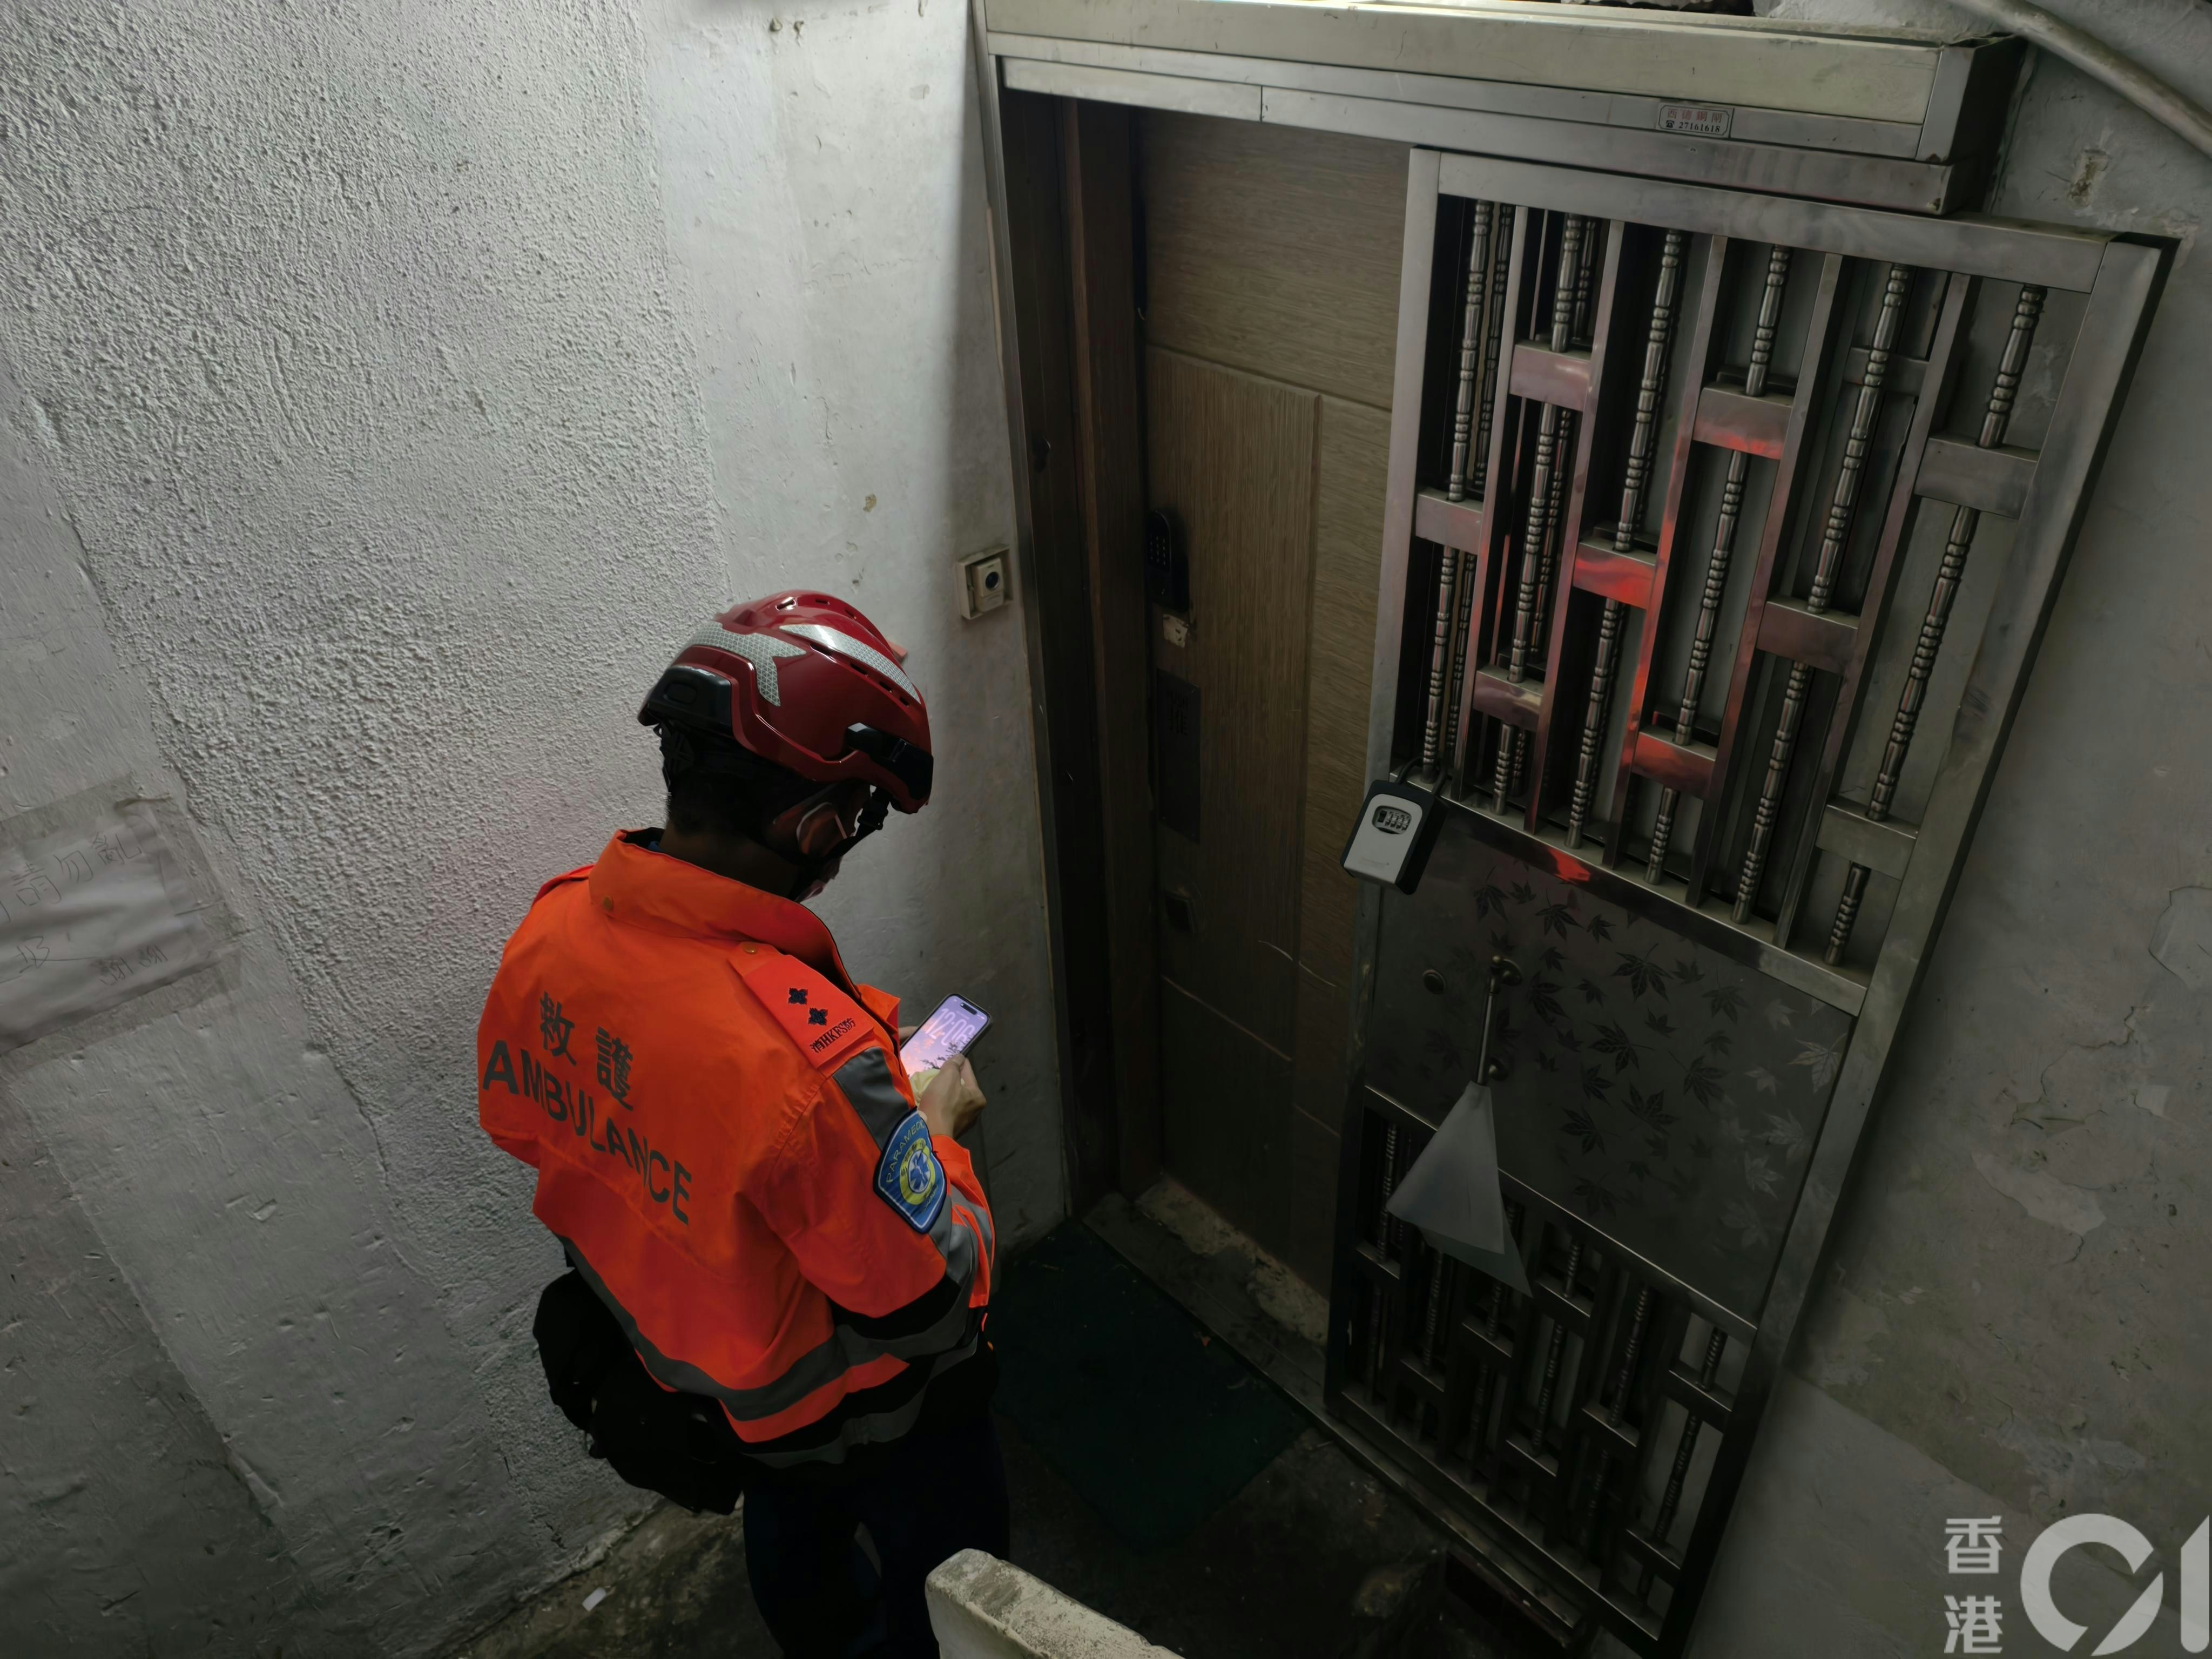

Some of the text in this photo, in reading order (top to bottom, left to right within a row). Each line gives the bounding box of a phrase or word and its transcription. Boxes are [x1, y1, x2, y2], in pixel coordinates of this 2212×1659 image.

[1678, 122, 1721, 132] 27161618
[0, 831, 142, 921] 請勿亂
[540, 991, 634, 1111] 救護
[925, 1008, 975, 1050] 12:06
[483, 1040, 692, 1226] AMBULANCE
